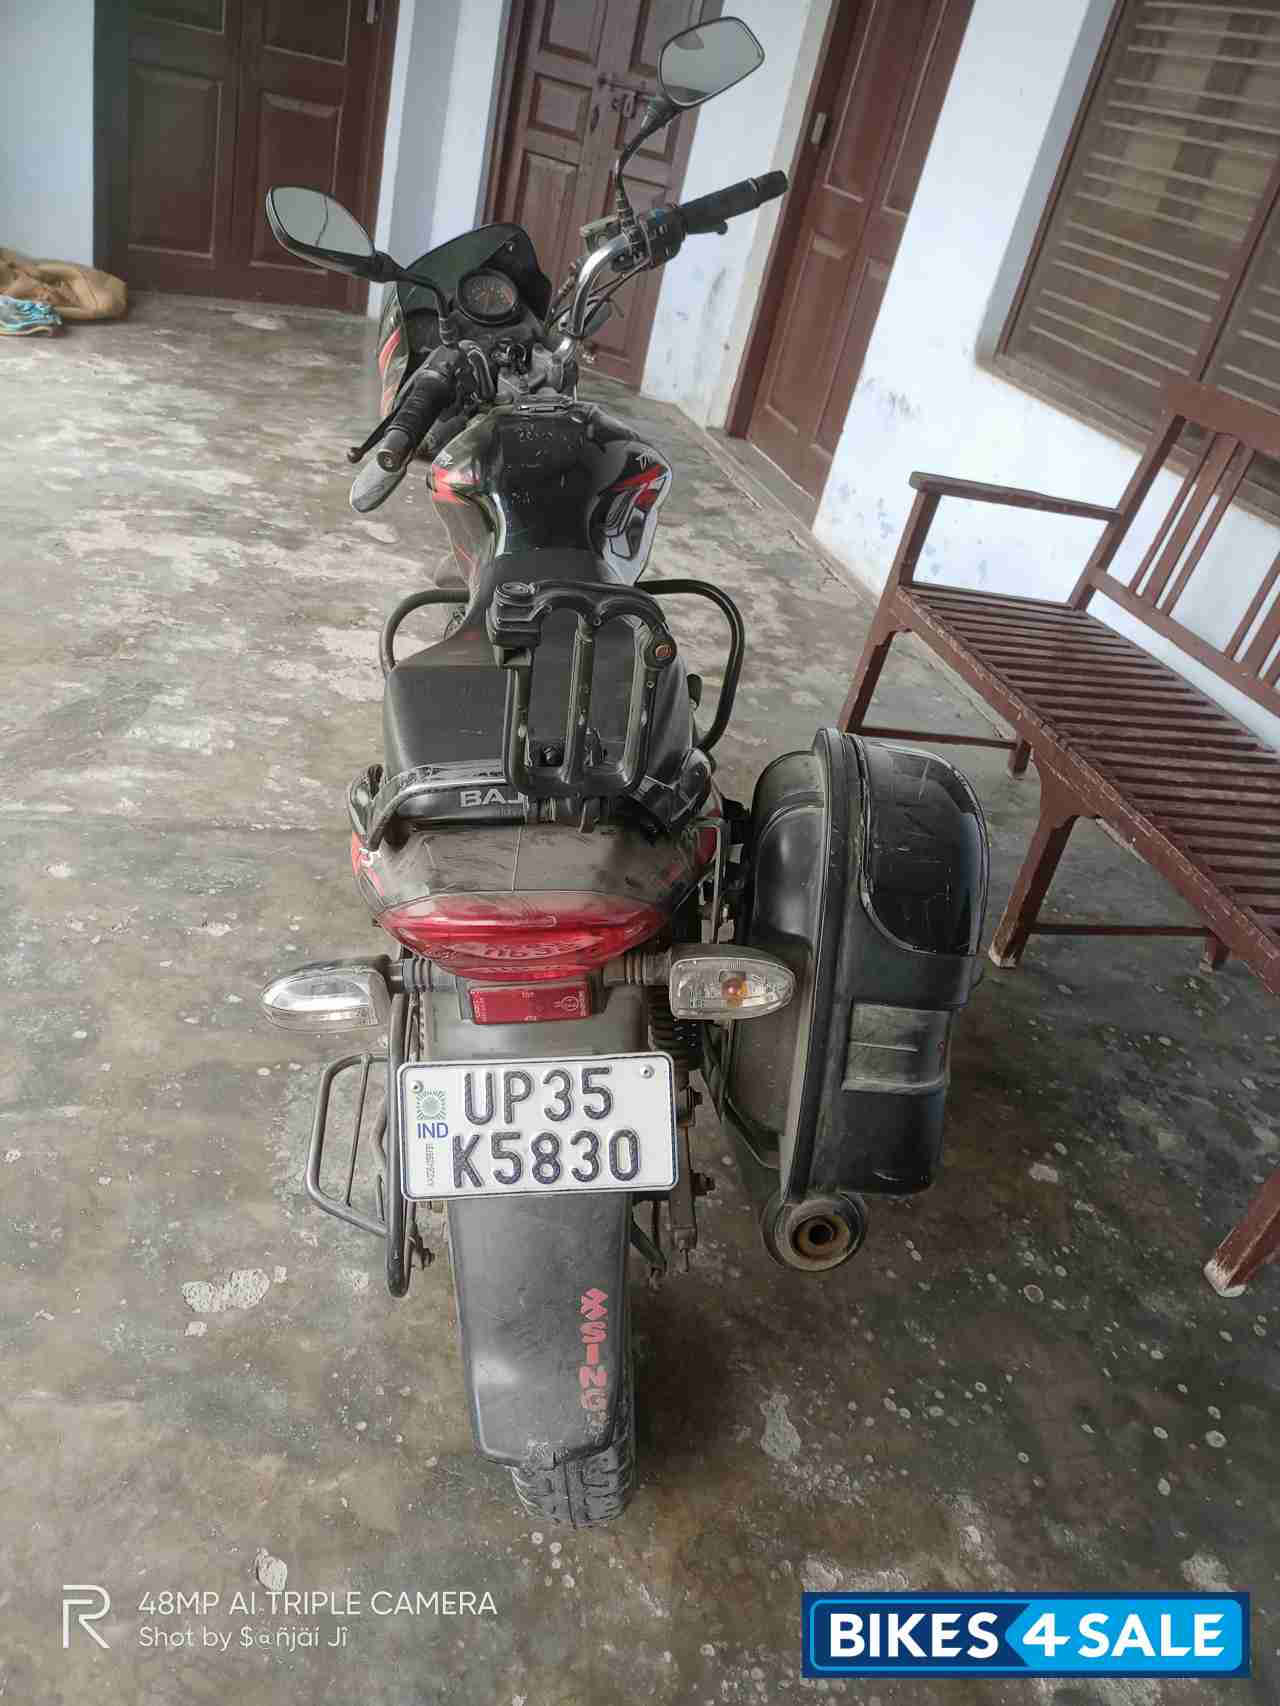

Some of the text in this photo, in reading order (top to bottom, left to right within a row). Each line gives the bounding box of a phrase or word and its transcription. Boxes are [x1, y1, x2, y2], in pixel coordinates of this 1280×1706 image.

[463, 1066, 612, 1125] UP35
[416, 1122, 449, 1138] IND
[451, 1128, 640, 1188] K5830
